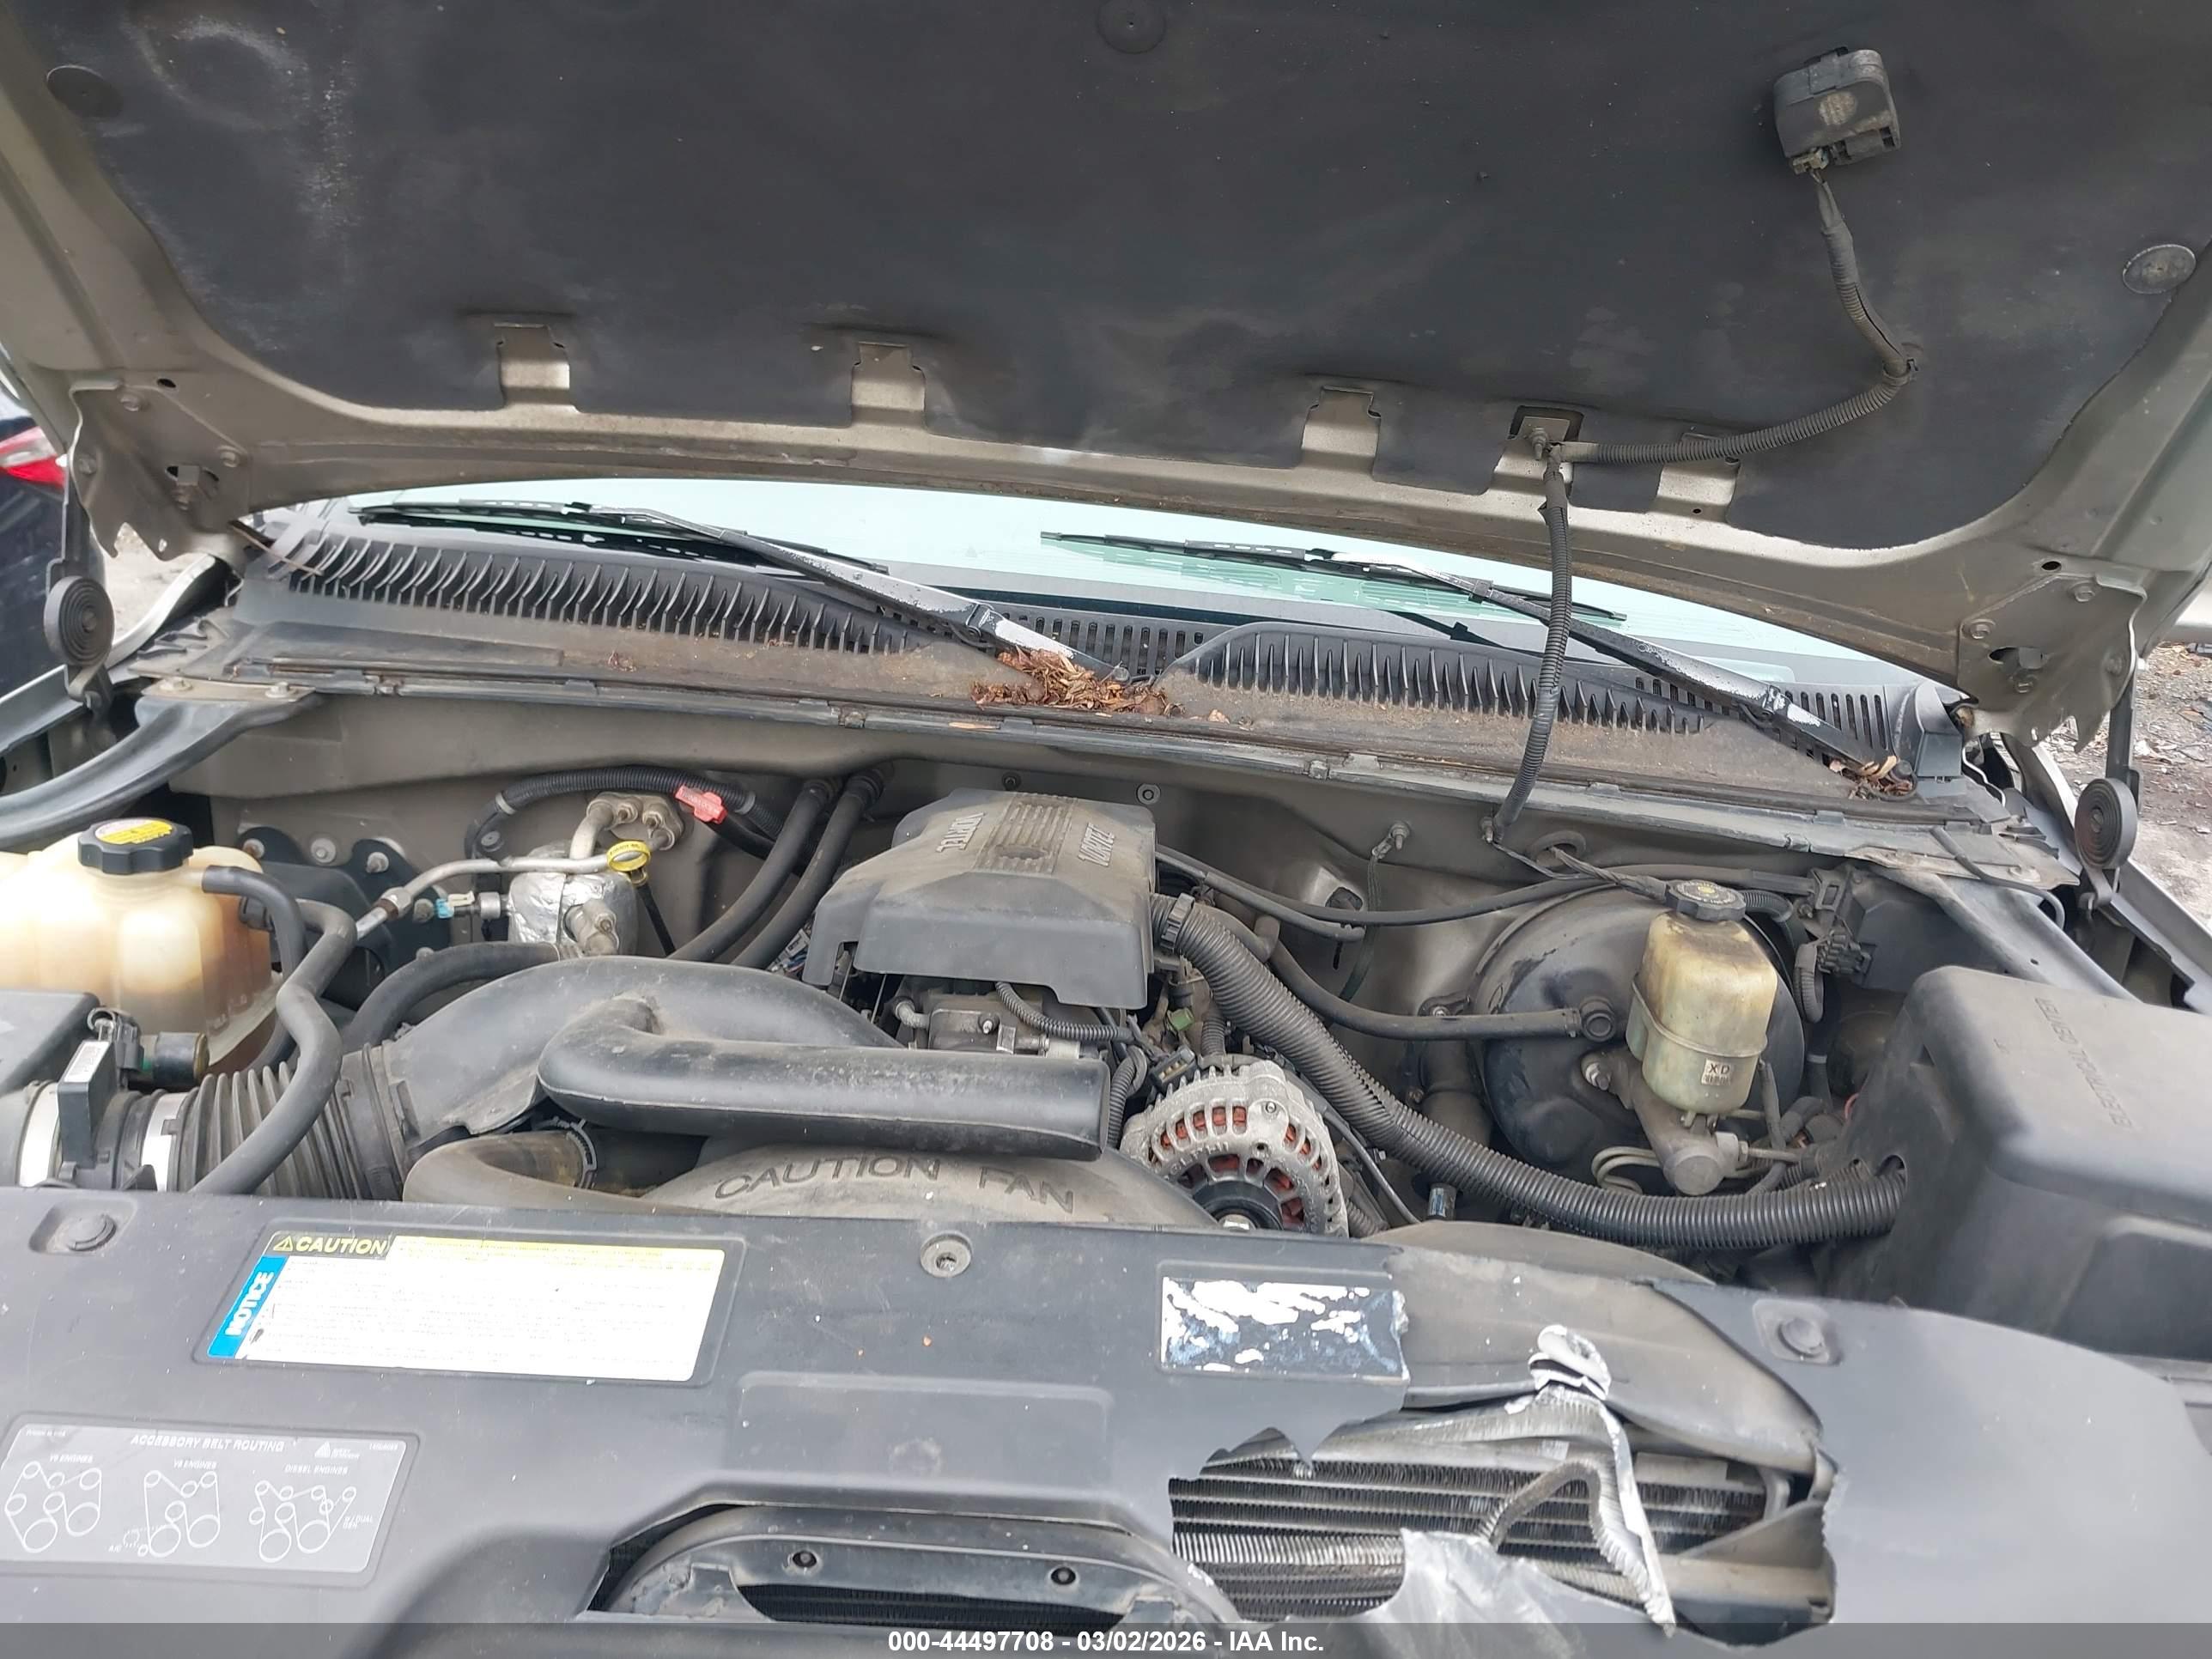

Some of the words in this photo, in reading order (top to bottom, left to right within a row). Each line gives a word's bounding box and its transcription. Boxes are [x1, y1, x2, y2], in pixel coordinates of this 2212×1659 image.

[1077, 822, 1115, 868] VORTEC
[714, 1156, 940, 1199] CAUTION
[977, 1165, 1074, 1214] FAN
[296, 1236, 387, 1255] CAUTION
[224, 1271, 275, 1335] NOTICE
[131, 1434, 203, 1449] ACCESSORY
[203, 1438, 233, 1449] BELT
[233, 1439, 285, 1452] ROUTING
